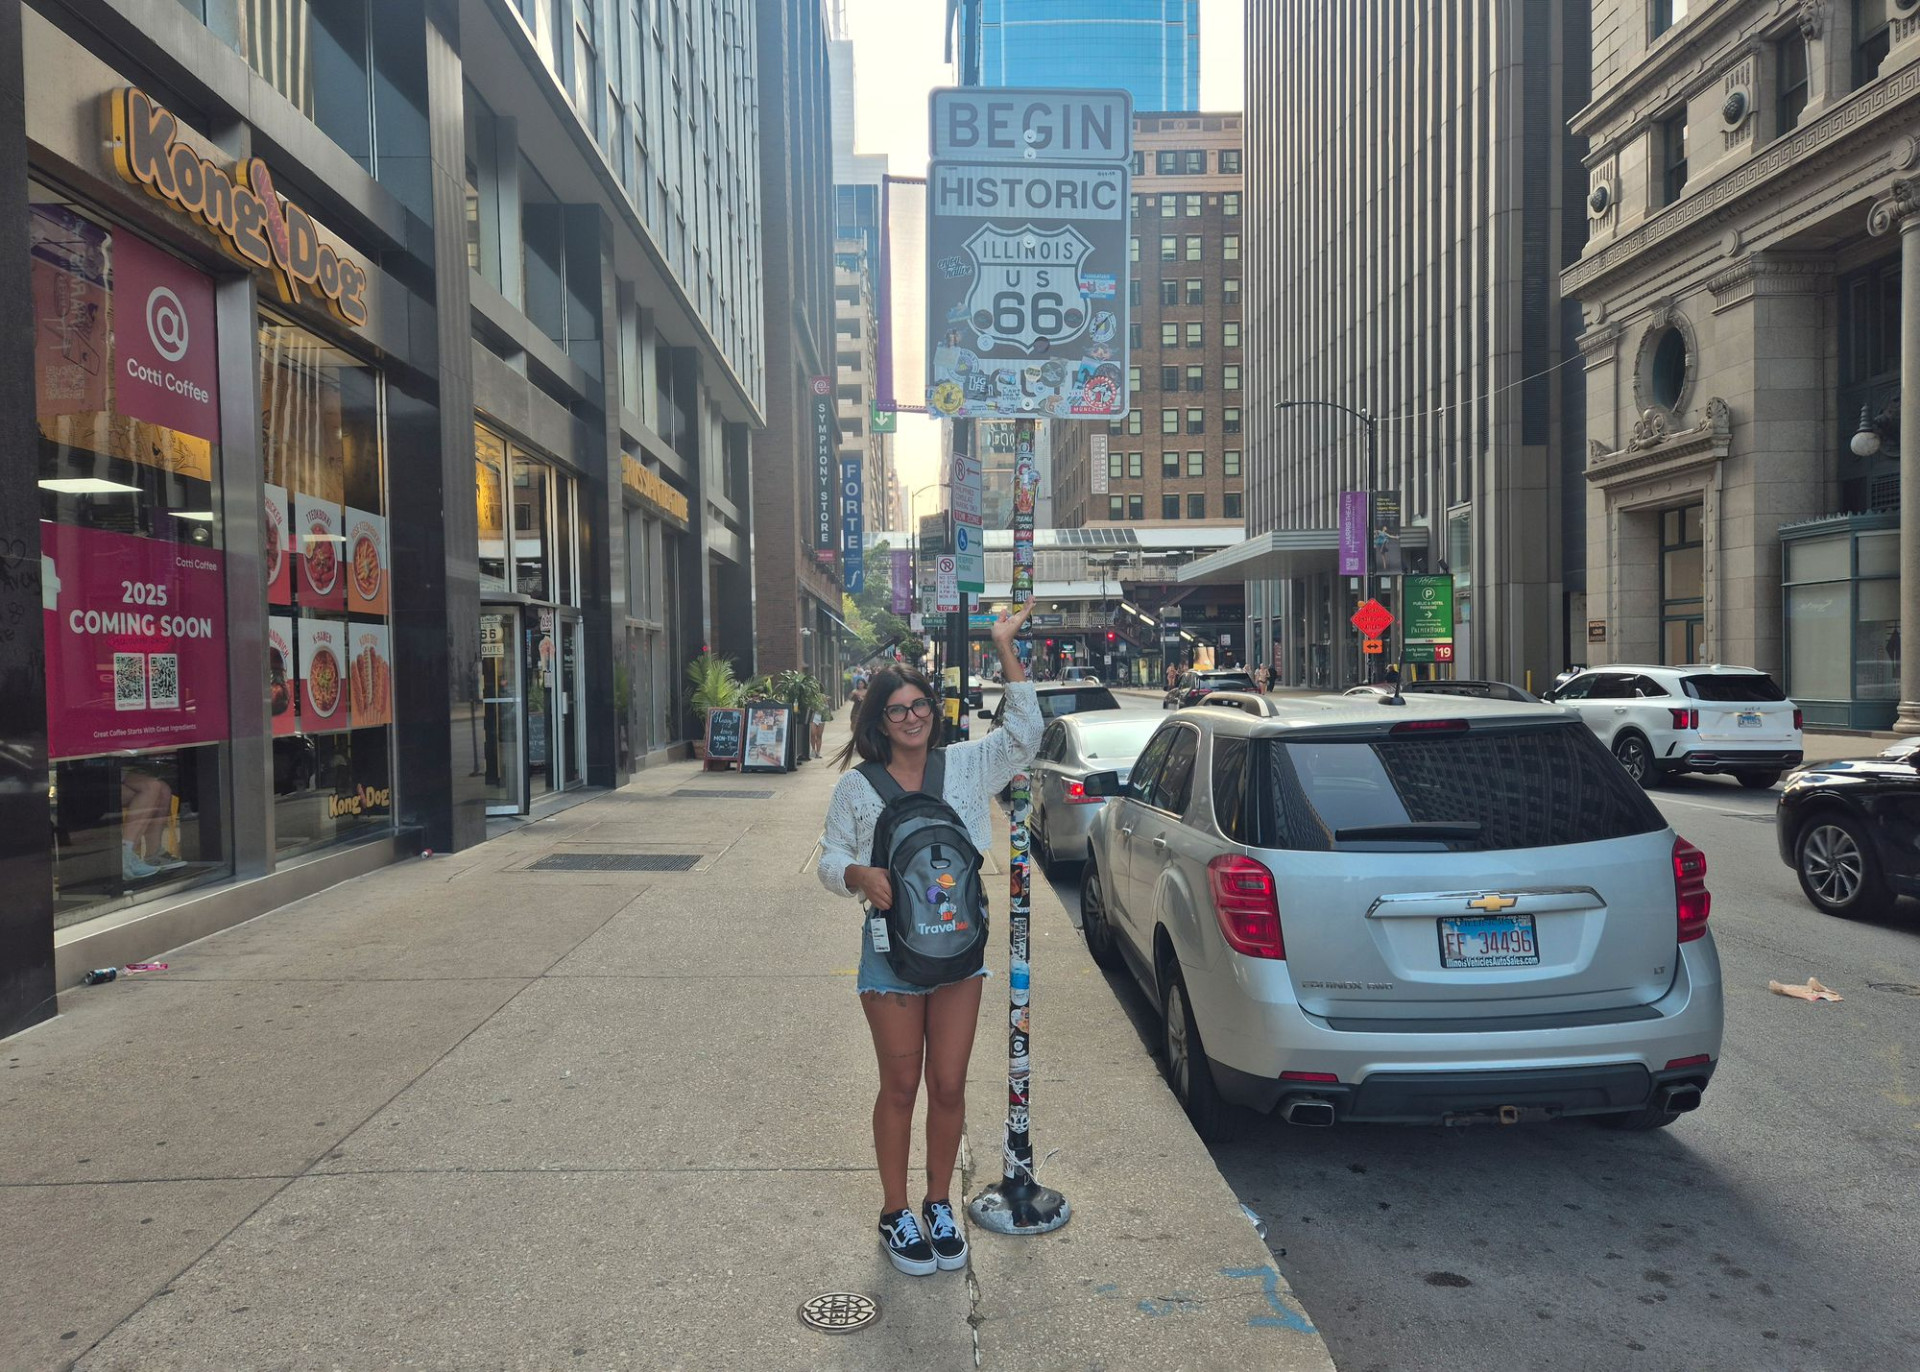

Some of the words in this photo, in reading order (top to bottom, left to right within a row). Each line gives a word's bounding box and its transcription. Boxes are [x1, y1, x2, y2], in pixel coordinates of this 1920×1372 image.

[949, 102, 1112, 150] BEGIN
[126, 86, 272, 268] Kong
[285, 201, 368, 327] Dog
[940, 177, 1117, 210] HISTORIC
[983, 241, 1074, 260] ILLINOIS
[1006, 270, 1021, 287] U
[1036, 271, 1050, 288] S
[993, 291, 1063, 335] 66
[127, 358, 162, 387] Cotti
[165, 372, 209, 403] Coffee
[818, 403, 828, 486] SYMPHONY
[820, 491, 829, 542] STORE
[845, 464, 858, 549] FORTE
[176, 557, 194, 568] Cotti
[195, 559, 217, 571] Coffee
[121, 580, 168, 606] 2025
[69, 609, 155, 636] COMING
[160, 614, 212, 638] SOON
[482, 645, 503, 653] OUTE
[1435, 647, 1451, 658] $19
[109, 729, 126, 738] Coffee
[127, 728, 143, 736] Starts
[143, 726, 155, 735] With
[156, 725, 169, 733] Great
[170, 723, 196, 733] Ingredients
[329, 793, 361, 818] Kong
[366, 785, 389, 808] Dog
[918, 919, 955, 935] Travel
[1478, 929, 1532, 955] 34496
[831, 1295, 848, 1324] WATER
